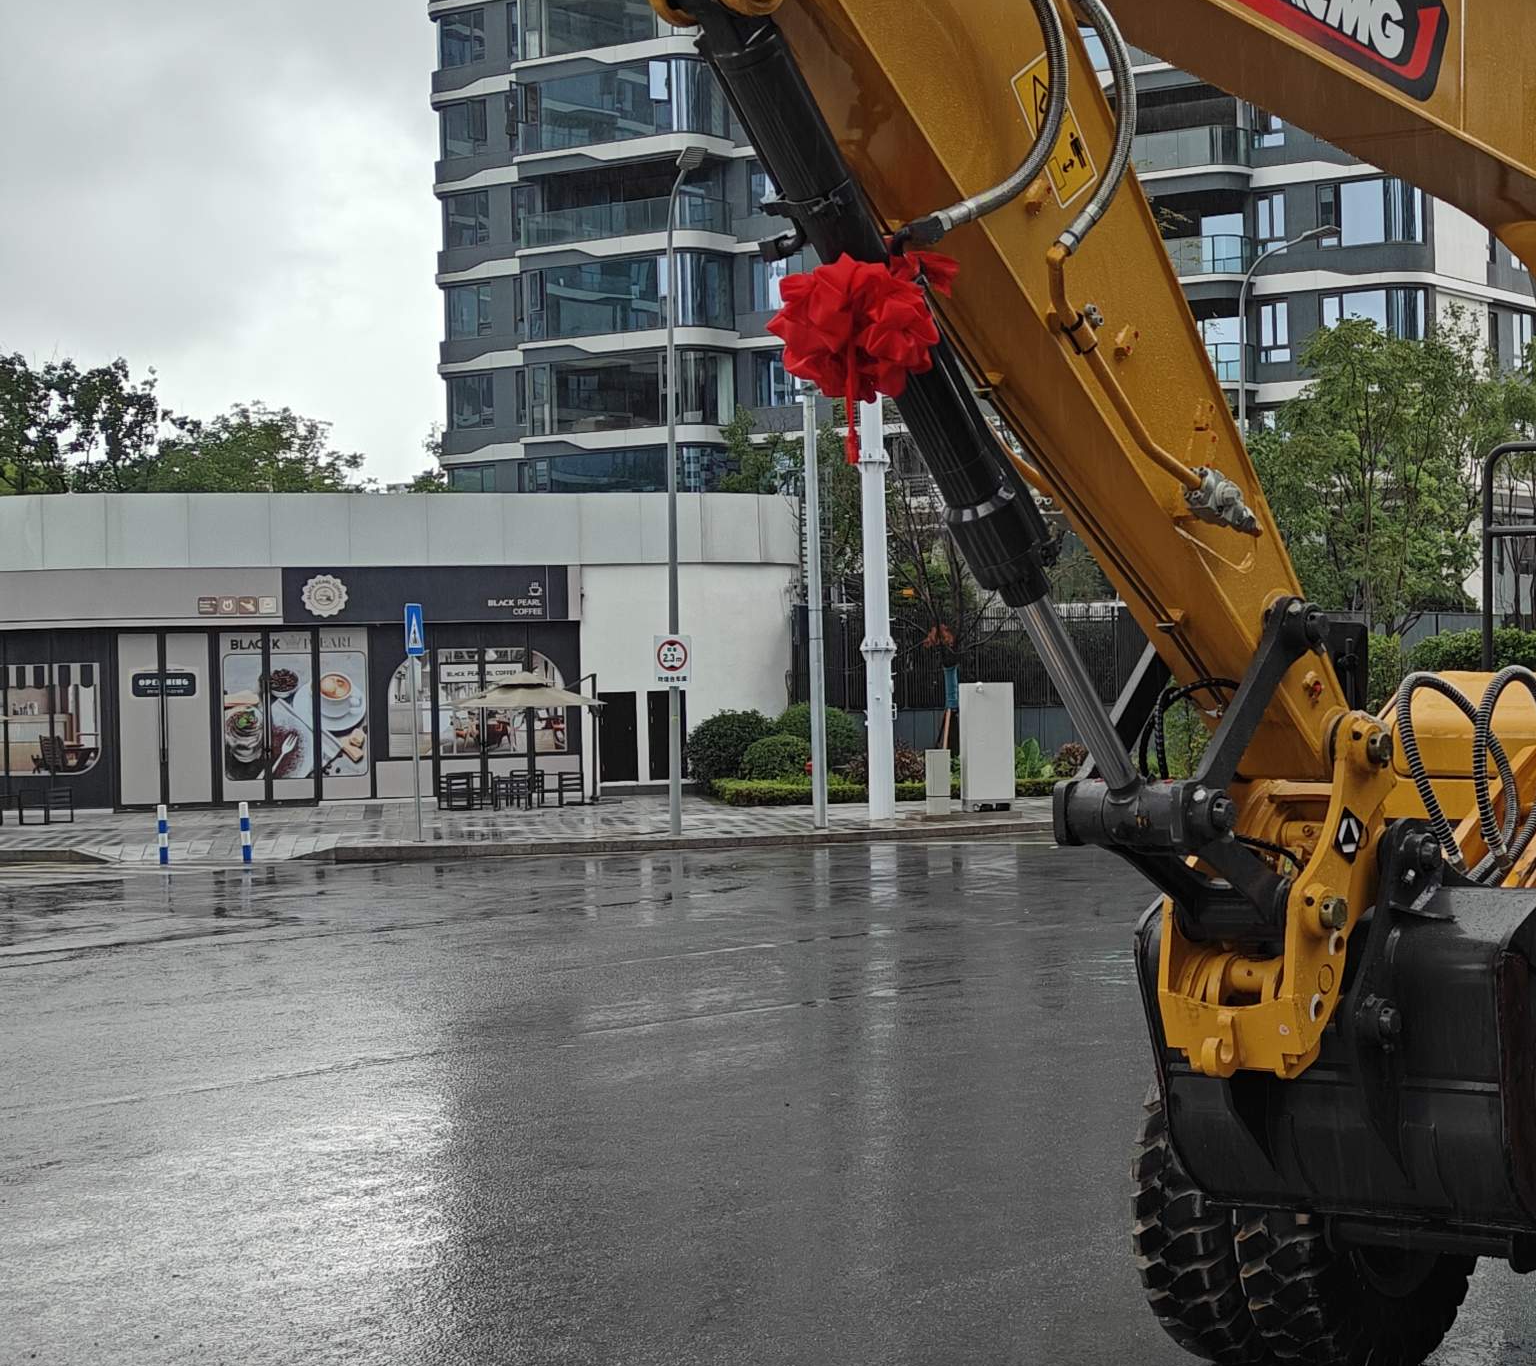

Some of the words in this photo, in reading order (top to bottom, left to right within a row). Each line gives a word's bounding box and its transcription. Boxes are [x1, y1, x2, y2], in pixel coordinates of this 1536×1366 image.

[487, 599, 515, 607] BLACK
[517, 598, 542, 606] PEARL
[512, 607, 543, 616] COFFEE
